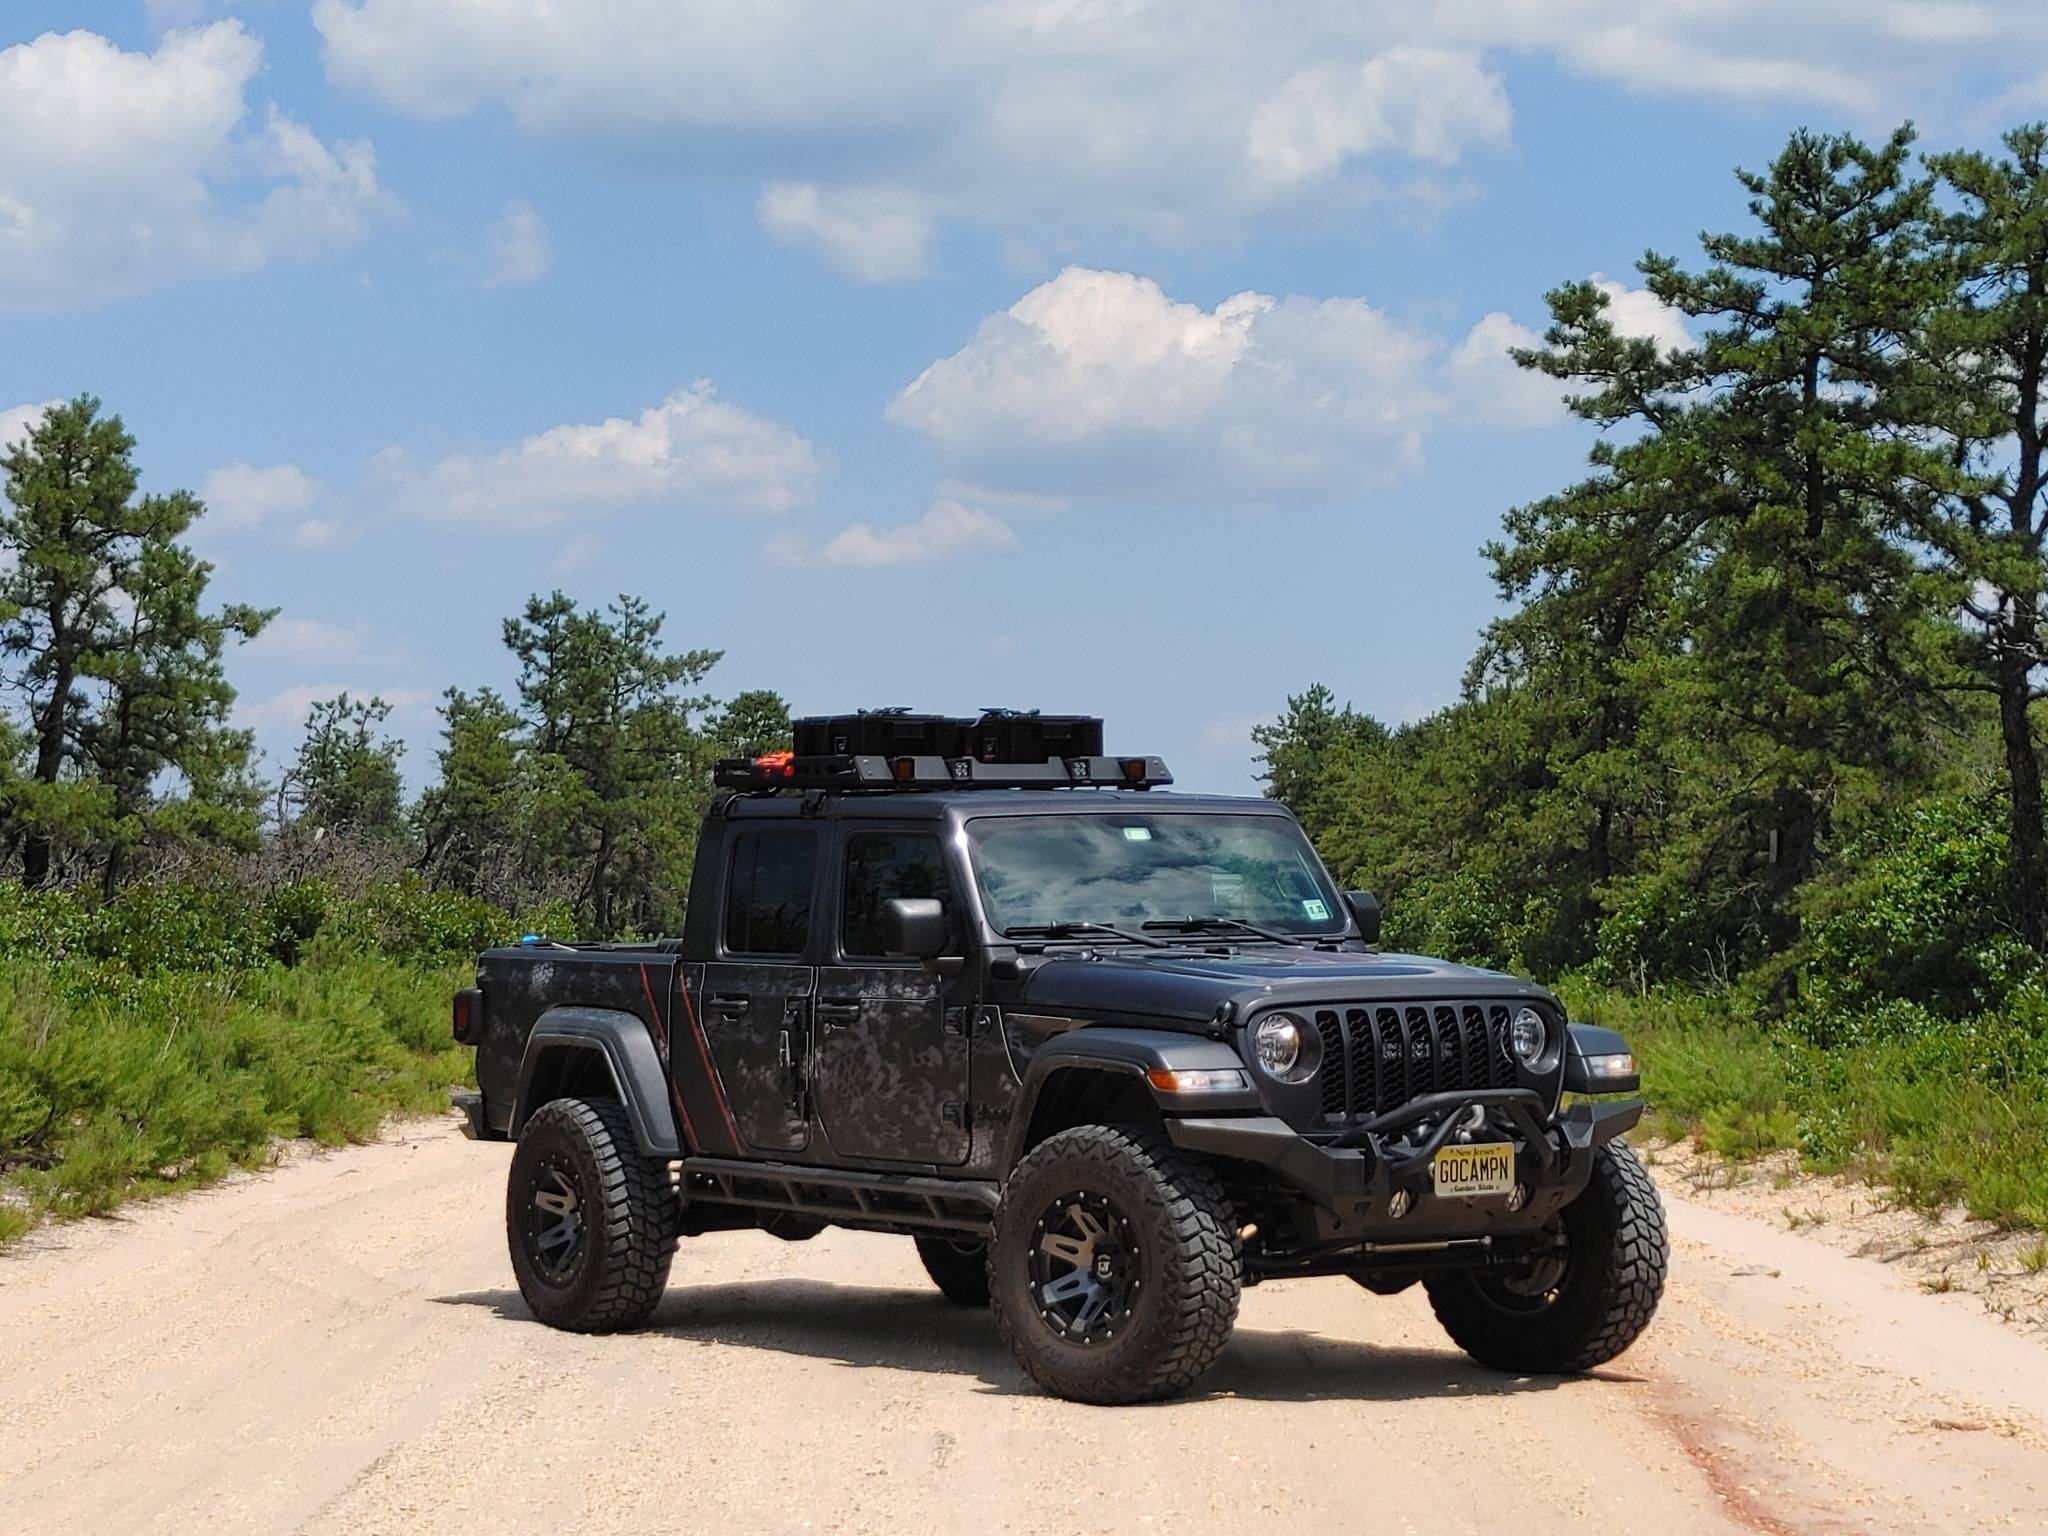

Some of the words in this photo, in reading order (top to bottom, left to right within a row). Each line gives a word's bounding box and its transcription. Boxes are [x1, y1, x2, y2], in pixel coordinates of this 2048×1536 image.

[1455, 1149, 1471, 1157] New
[1473, 1147, 1495, 1157] Jersey
[1440, 1156, 1508, 1183] GOCAMPN
